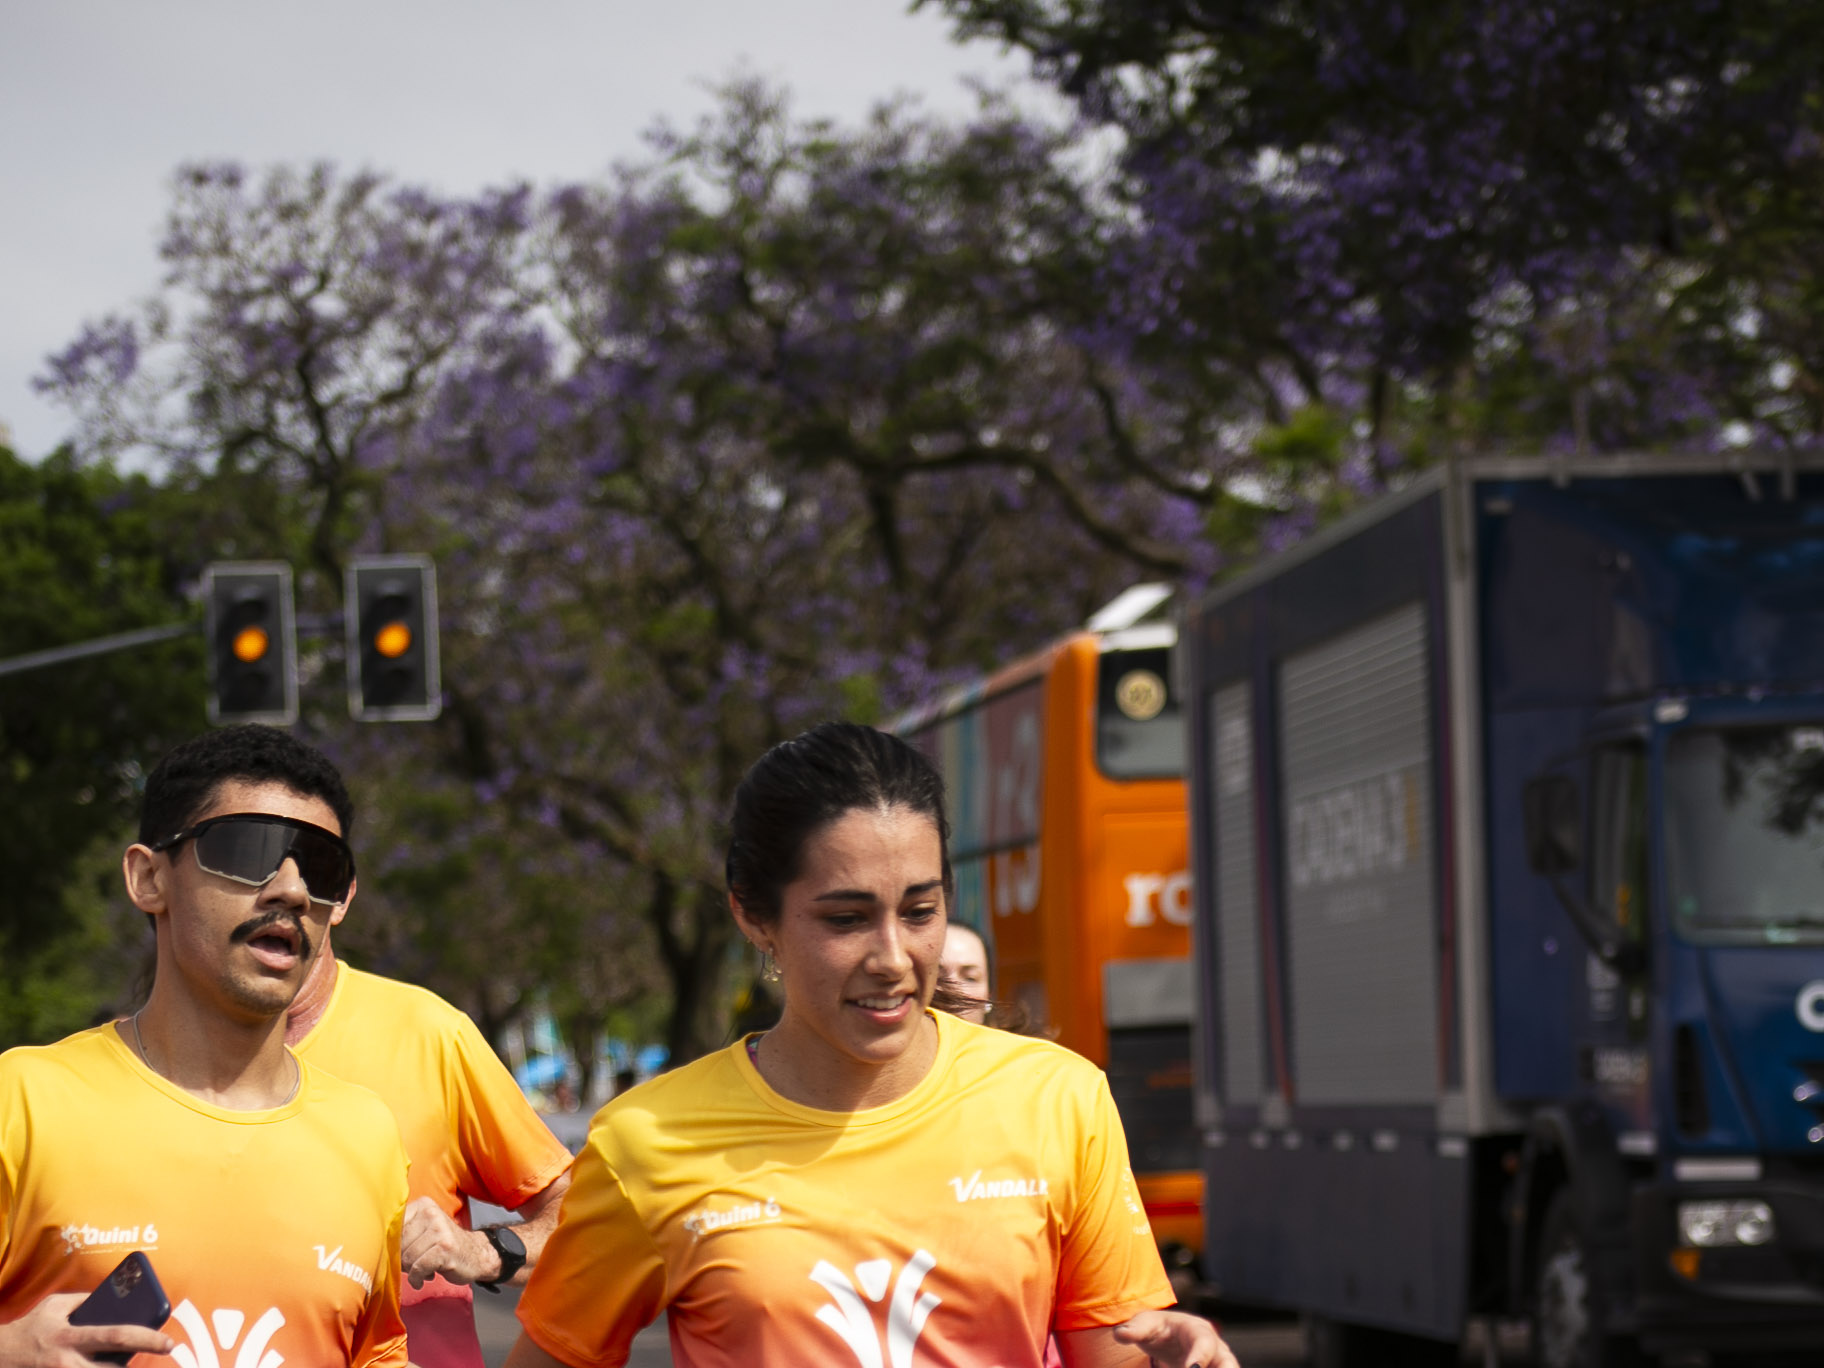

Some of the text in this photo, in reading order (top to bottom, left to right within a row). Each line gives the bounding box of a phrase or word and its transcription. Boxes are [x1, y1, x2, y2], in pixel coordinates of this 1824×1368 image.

[705, 1202, 761, 1230] Quini
[764, 1196, 782, 1217] 6
[83, 1223, 159, 1246] Quini 6
